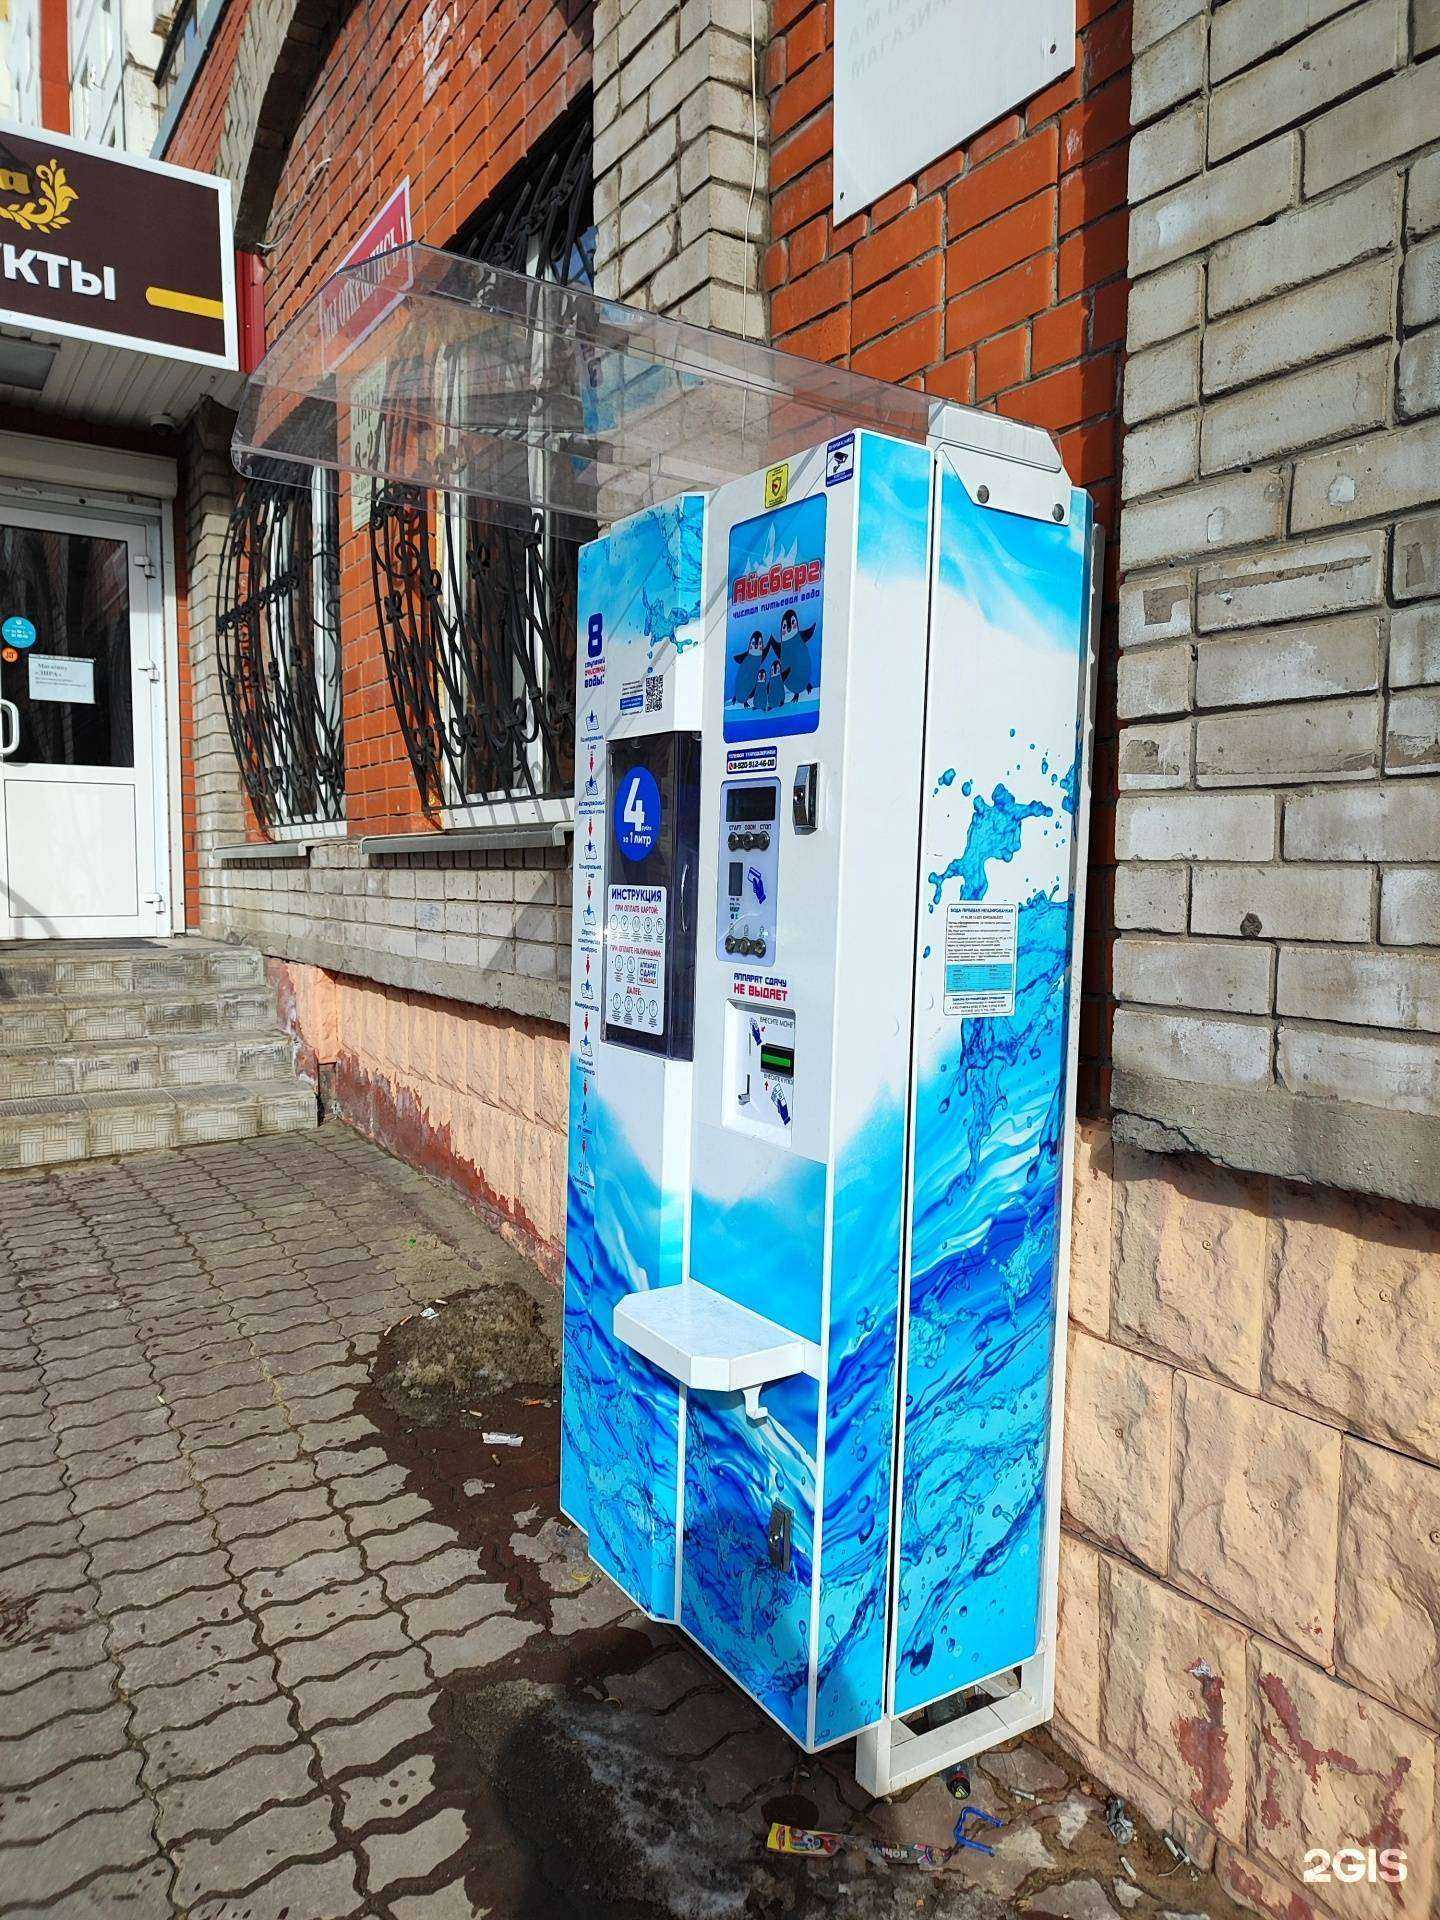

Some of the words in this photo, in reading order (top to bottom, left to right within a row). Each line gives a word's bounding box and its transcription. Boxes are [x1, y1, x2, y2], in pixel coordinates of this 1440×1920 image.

[0, 242, 117, 301] КТЫ
[732, 560, 822, 606] Айсберг
[733, 603, 759, 619] чистая
[760, 595, 799, 613] питьевая
[800, 588, 820, 603] вода
[587, 612, 603, 658] 8
[623, 777, 645, 832] 4
[634, 835, 652, 847] литр
[611, 888, 662, 904] ИНСТРУКЦИЯ
[733, 972, 764, 984] АППАРАТ
[764, 976, 788, 988] СДАЧУ
[733, 982, 746, 995] НЕ
[748, 984, 788, 1001] ВЫДАЕТ
